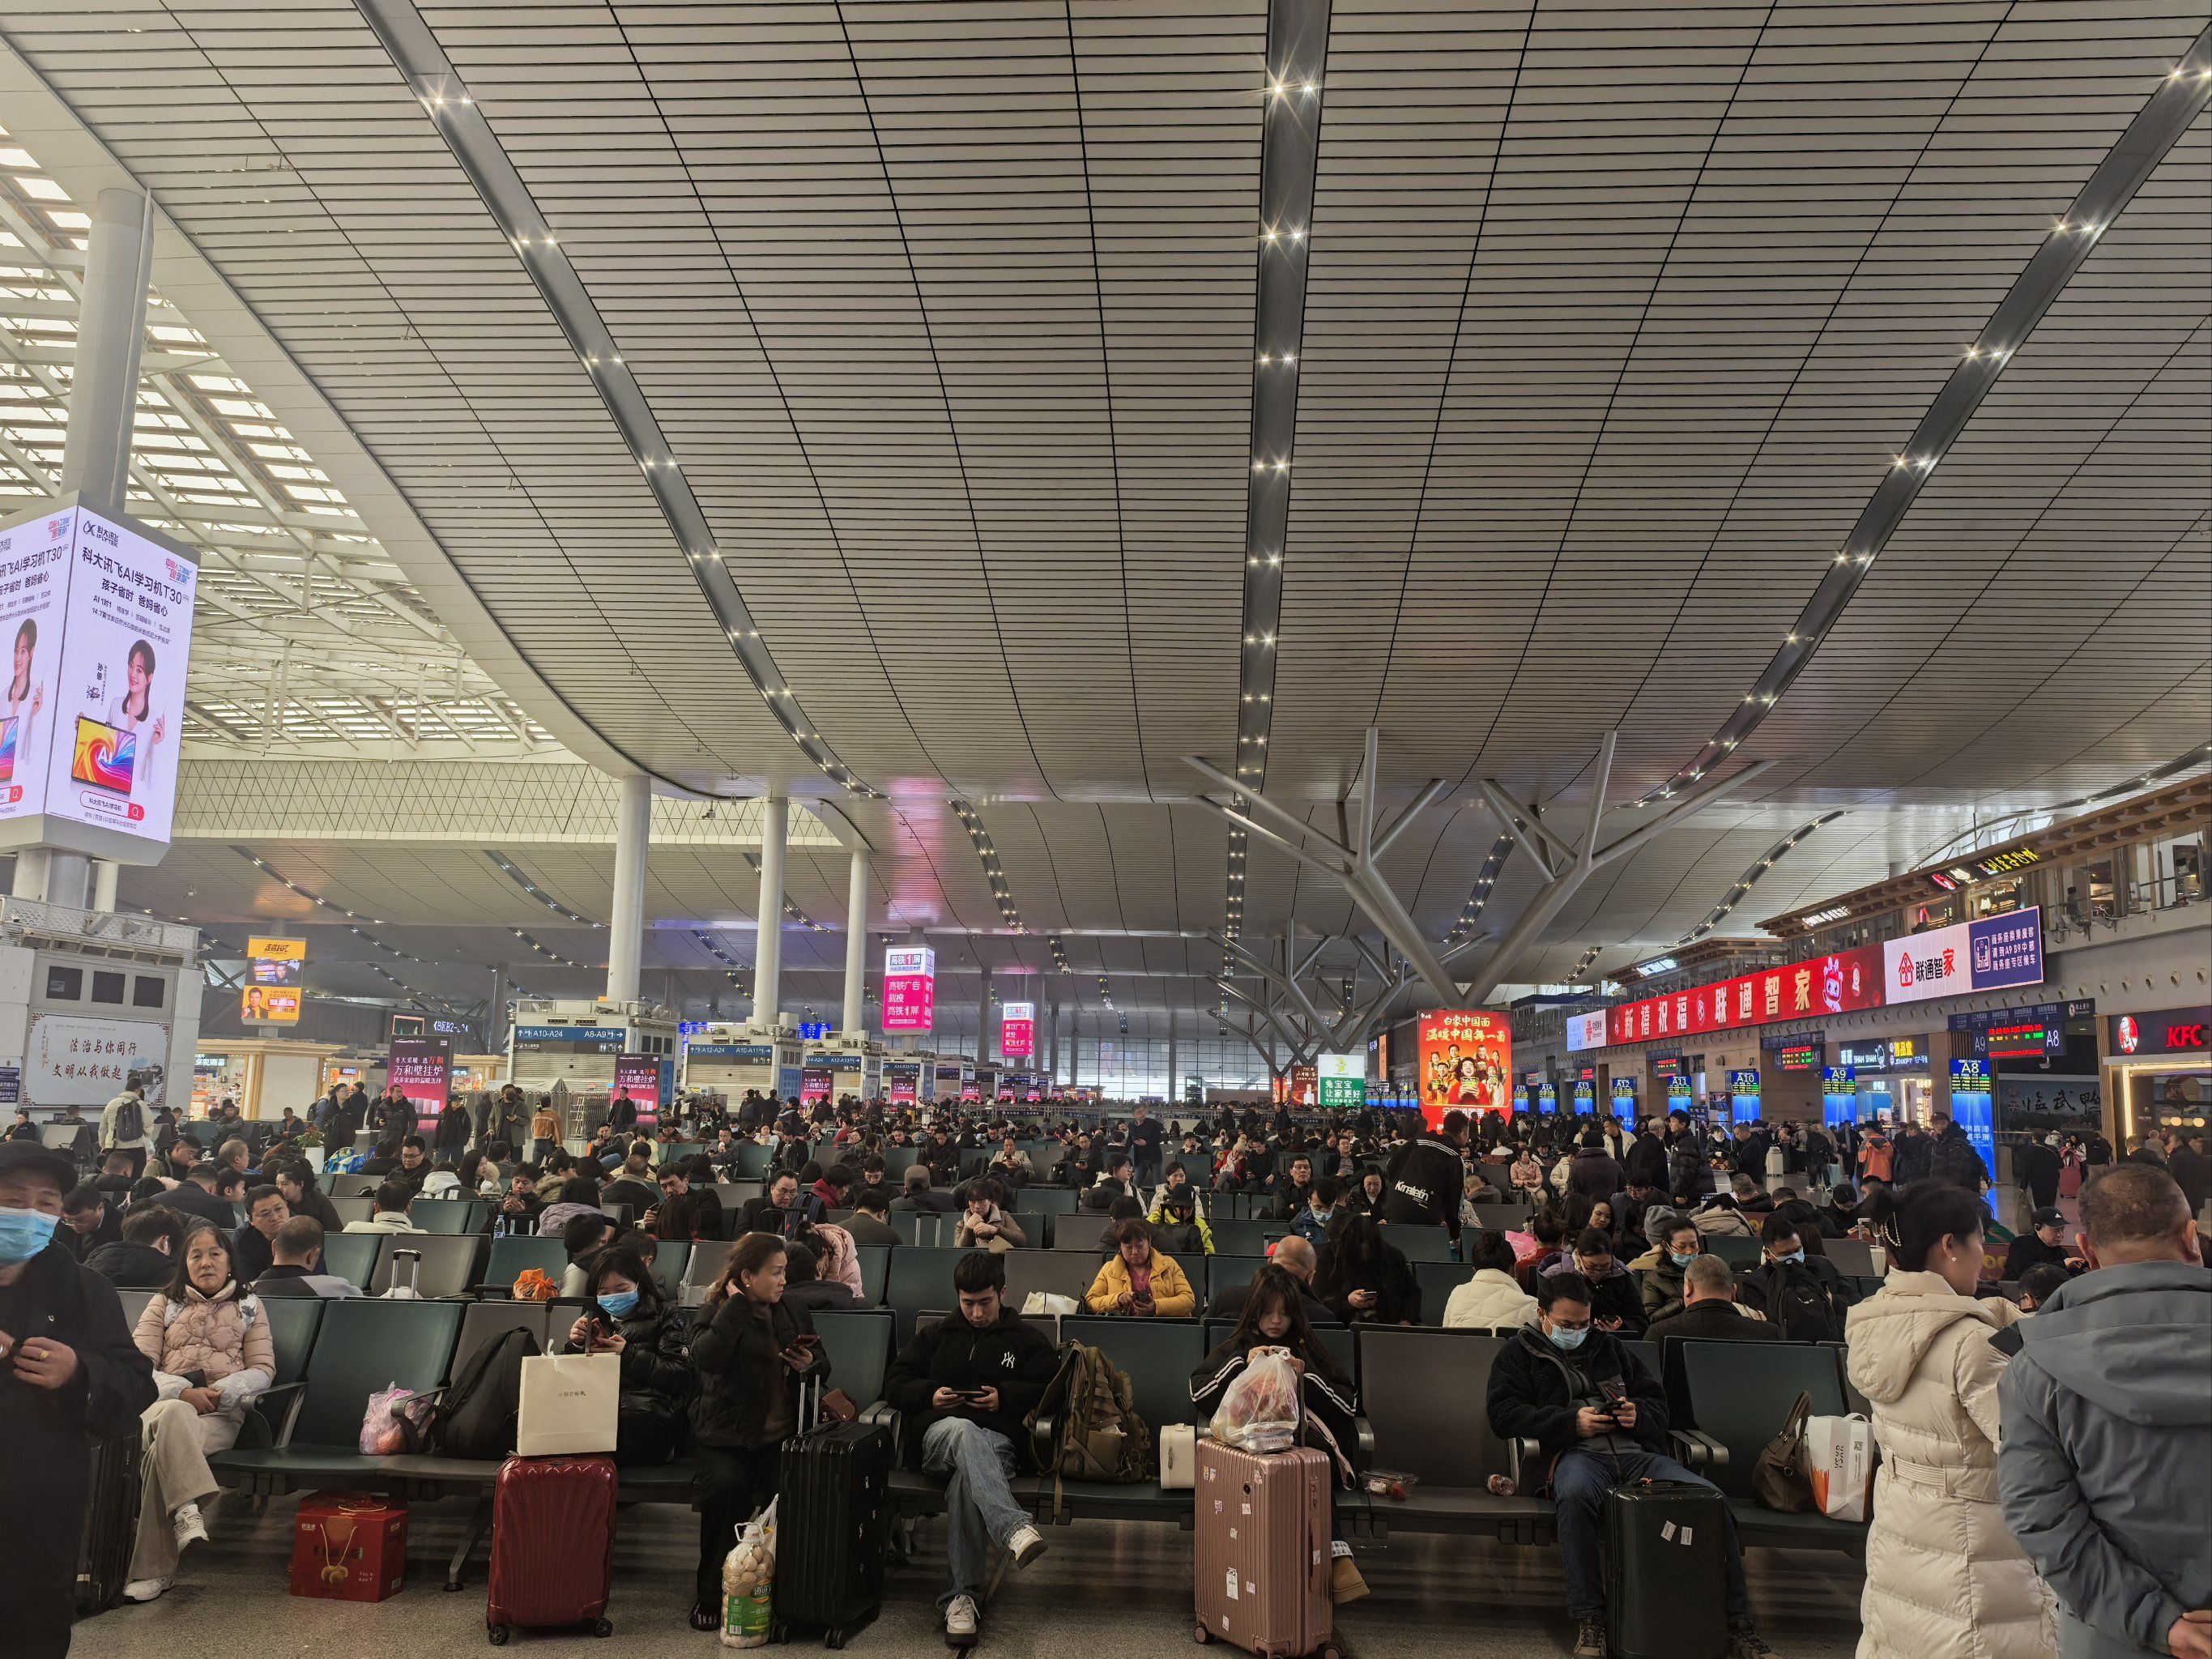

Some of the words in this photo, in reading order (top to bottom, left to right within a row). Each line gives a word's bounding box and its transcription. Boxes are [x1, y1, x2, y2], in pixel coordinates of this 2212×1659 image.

[97, 526, 118, 542] 科大讯飞
[83, 547, 182, 604] 科大讯飞AI学习机T30
[102, 578, 134, 602] 孩子省时
[139, 595, 168, 616] 爸妈省心
[1991, 926, 2034, 945] 商务座换乘旅客
[890, 954, 921, 966] 高铁1屏
[1916, 949, 1955, 982] 联通智家
[1993, 954, 2035, 971] 商务座专区候车
[889, 981, 920, 991] 高铁广告
[888, 993, 904, 1003] 就投
[1624, 996, 1687, 1038] 新禧祝福
[1715, 969, 1811, 1024] 联通智家
[888, 1005, 919, 1016] 高铁1屏
[1443, 1015, 1490, 1027] 白象中国面
[1426, 1028, 1506, 1043] 温暖中国每一面
[2047, 1030, 2059, 1047] A8
[2166, 1024, 2202, 1047] KFC
[70, 1038, 137, 1056] 法治与你同行
[1975, 1036, 1984, 1051] A9
[52, 1063, 122, 1080] 文明从我做起
[394, 1064, 443, 1077] 万和壁挂炉
[1831, 1069, 1847, 1078] A9
[1961, 1063, 1979, 1073] A8
[619, 1075, 656, 1084] 万和壁挂炉
[1325, 1080, 1352, 1089] 兔宝宝
[1616, 1080, 1630, 1088] A12
[1737, 1073, 1754, 1082] A10
[1325, 1090, 1361, 1098] 让家更好
